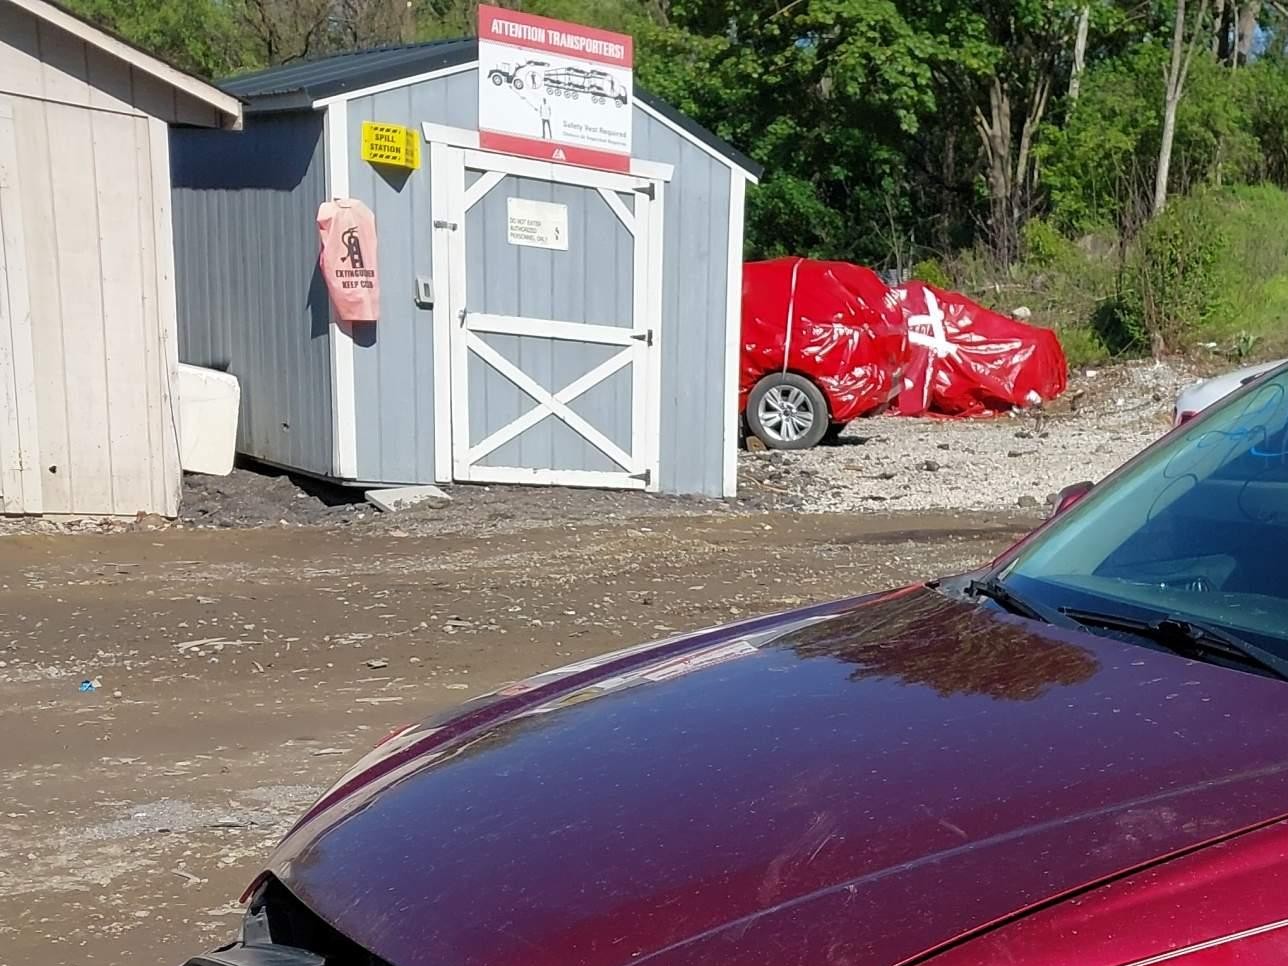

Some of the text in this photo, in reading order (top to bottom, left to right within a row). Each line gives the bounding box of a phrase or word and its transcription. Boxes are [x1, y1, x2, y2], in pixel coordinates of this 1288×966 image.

[491, 18, 624, 59] ATTENTION TRANSPORTERS!
[374, 133, 396, 143] SPILL
[370, 143, 401, 154] STATION
[342, 281, 359, 289] KEEP
